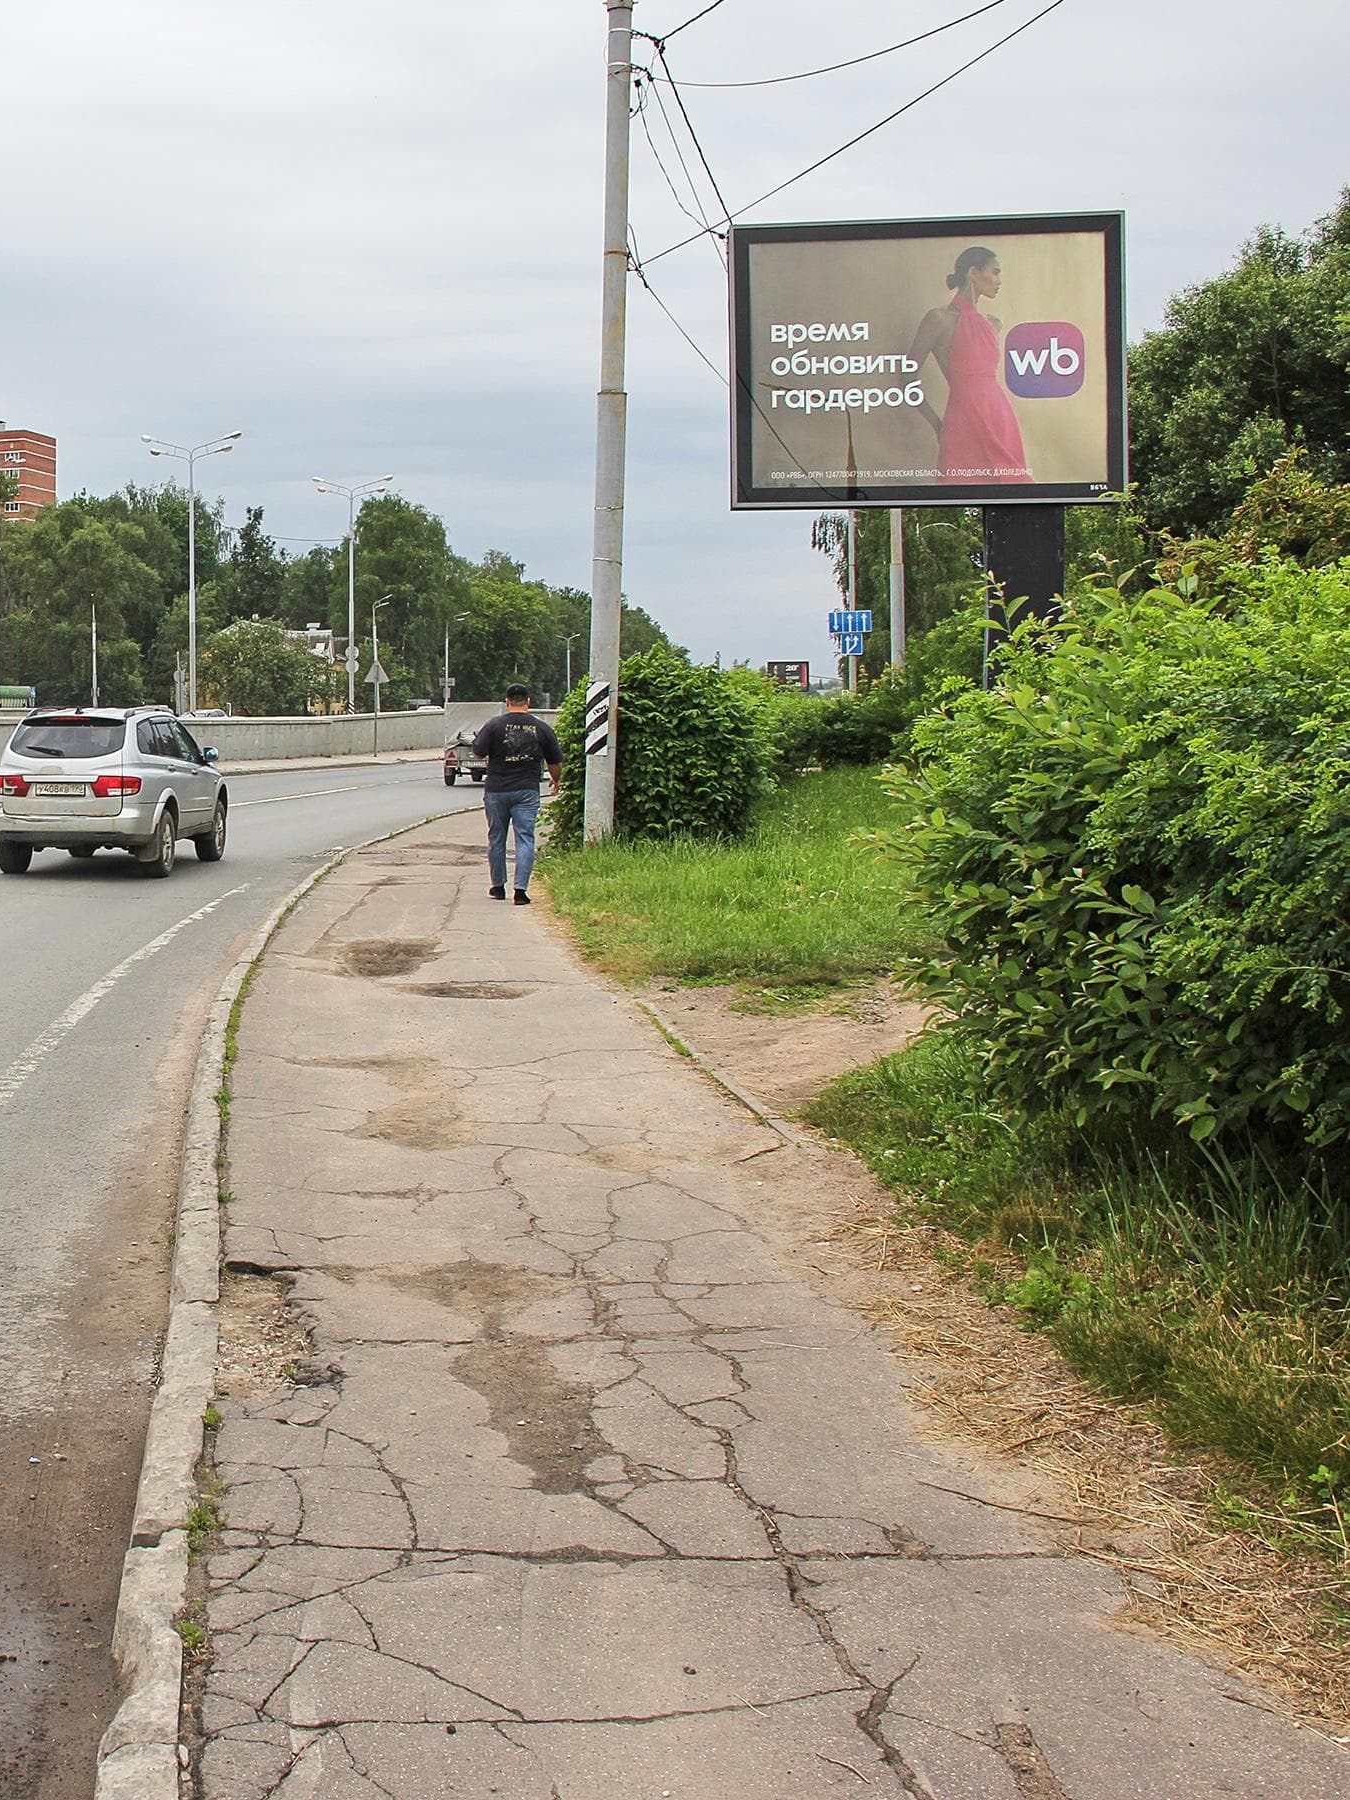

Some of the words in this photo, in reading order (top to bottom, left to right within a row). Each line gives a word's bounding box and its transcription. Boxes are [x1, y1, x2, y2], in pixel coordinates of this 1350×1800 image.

[770, 322, 869, 349] время
[770, 349, 918, 376] обновить
[1009, 337, 1080, 376] wb
[771, 380, 924, 415] гардероб
